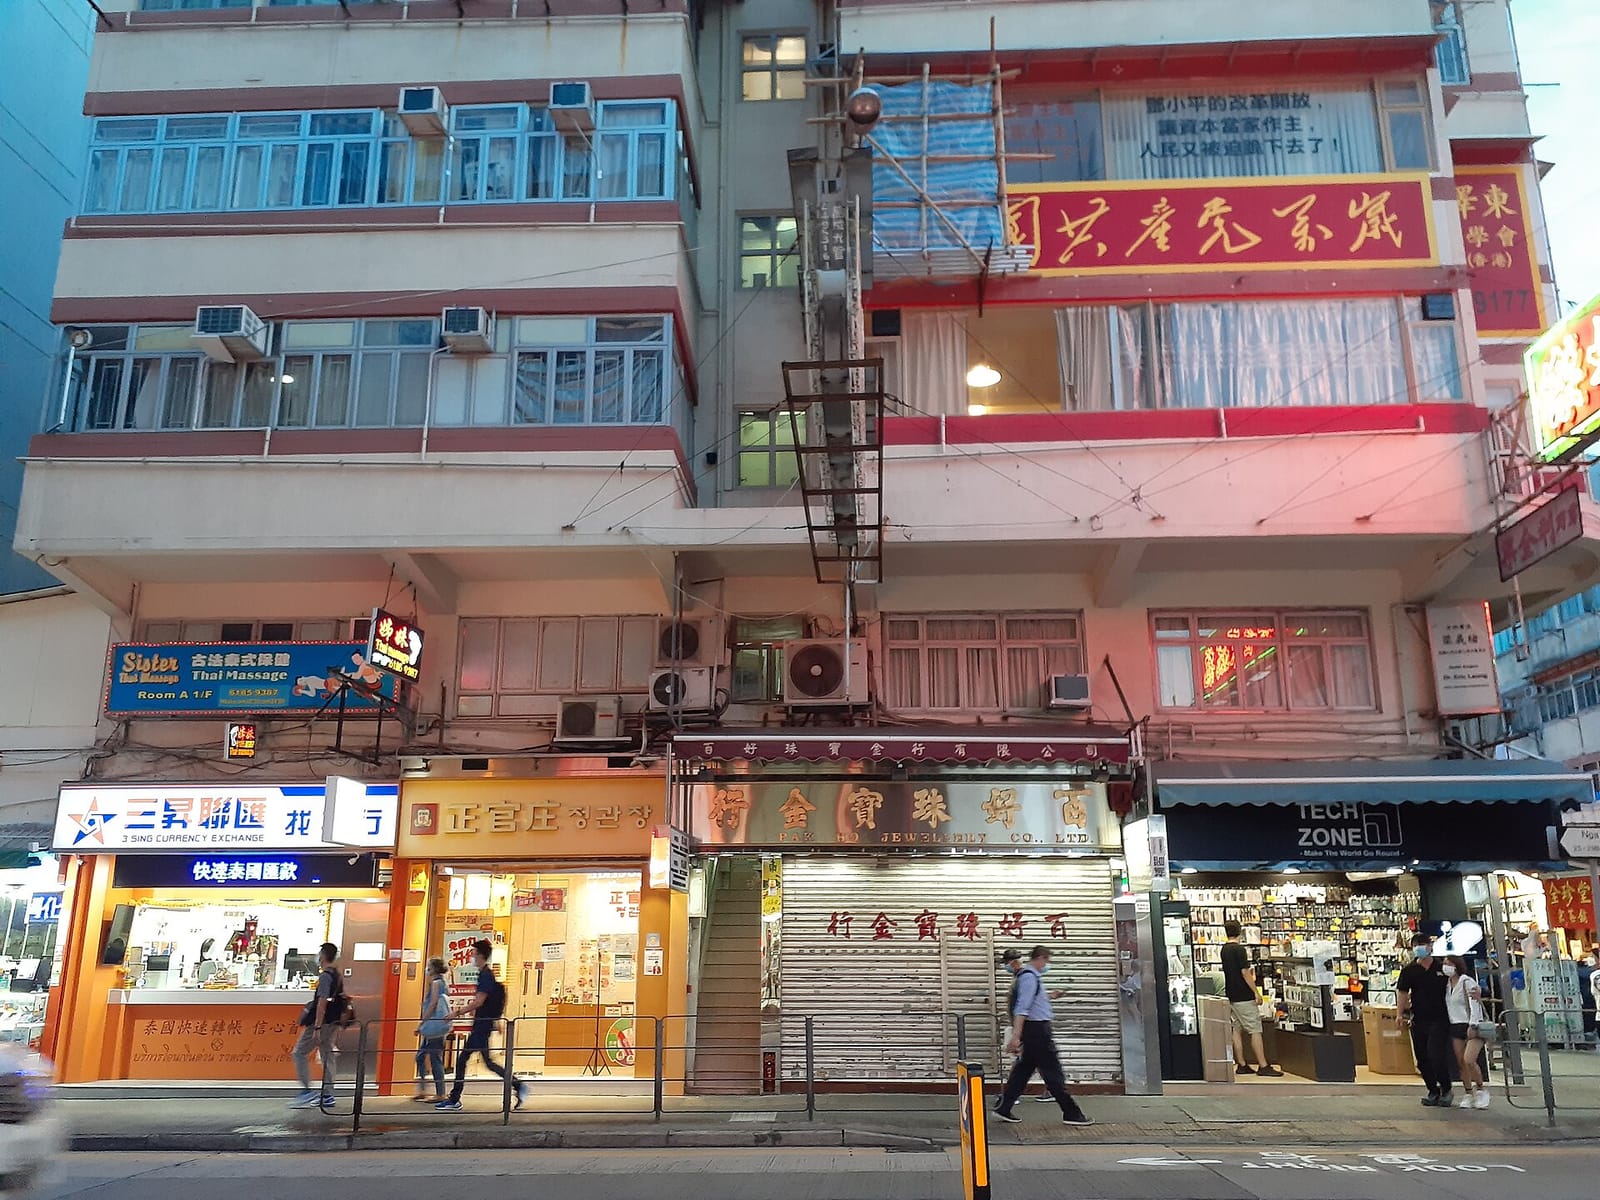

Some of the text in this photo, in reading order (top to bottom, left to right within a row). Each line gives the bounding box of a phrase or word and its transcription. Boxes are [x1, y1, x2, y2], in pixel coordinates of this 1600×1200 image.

[123, 652, 179, 673] Sister
[191, 670, 288, 682] Thai Massage
[138, 690, 213, 700] Room A 1/F
[445, 801, 561, 833] 正官庄
[568, 804, 652, 829] 정관장
[1300, 801, 1359, 819] TECH
[131, 835, 153, 843] SING
[156, 834, 207, 843] CURRENCY
[211, 834, 264, 842] EXCHANGE
[1298, 828, 1363, 846] ZONE
[1325, 849, 1338, 857] The
